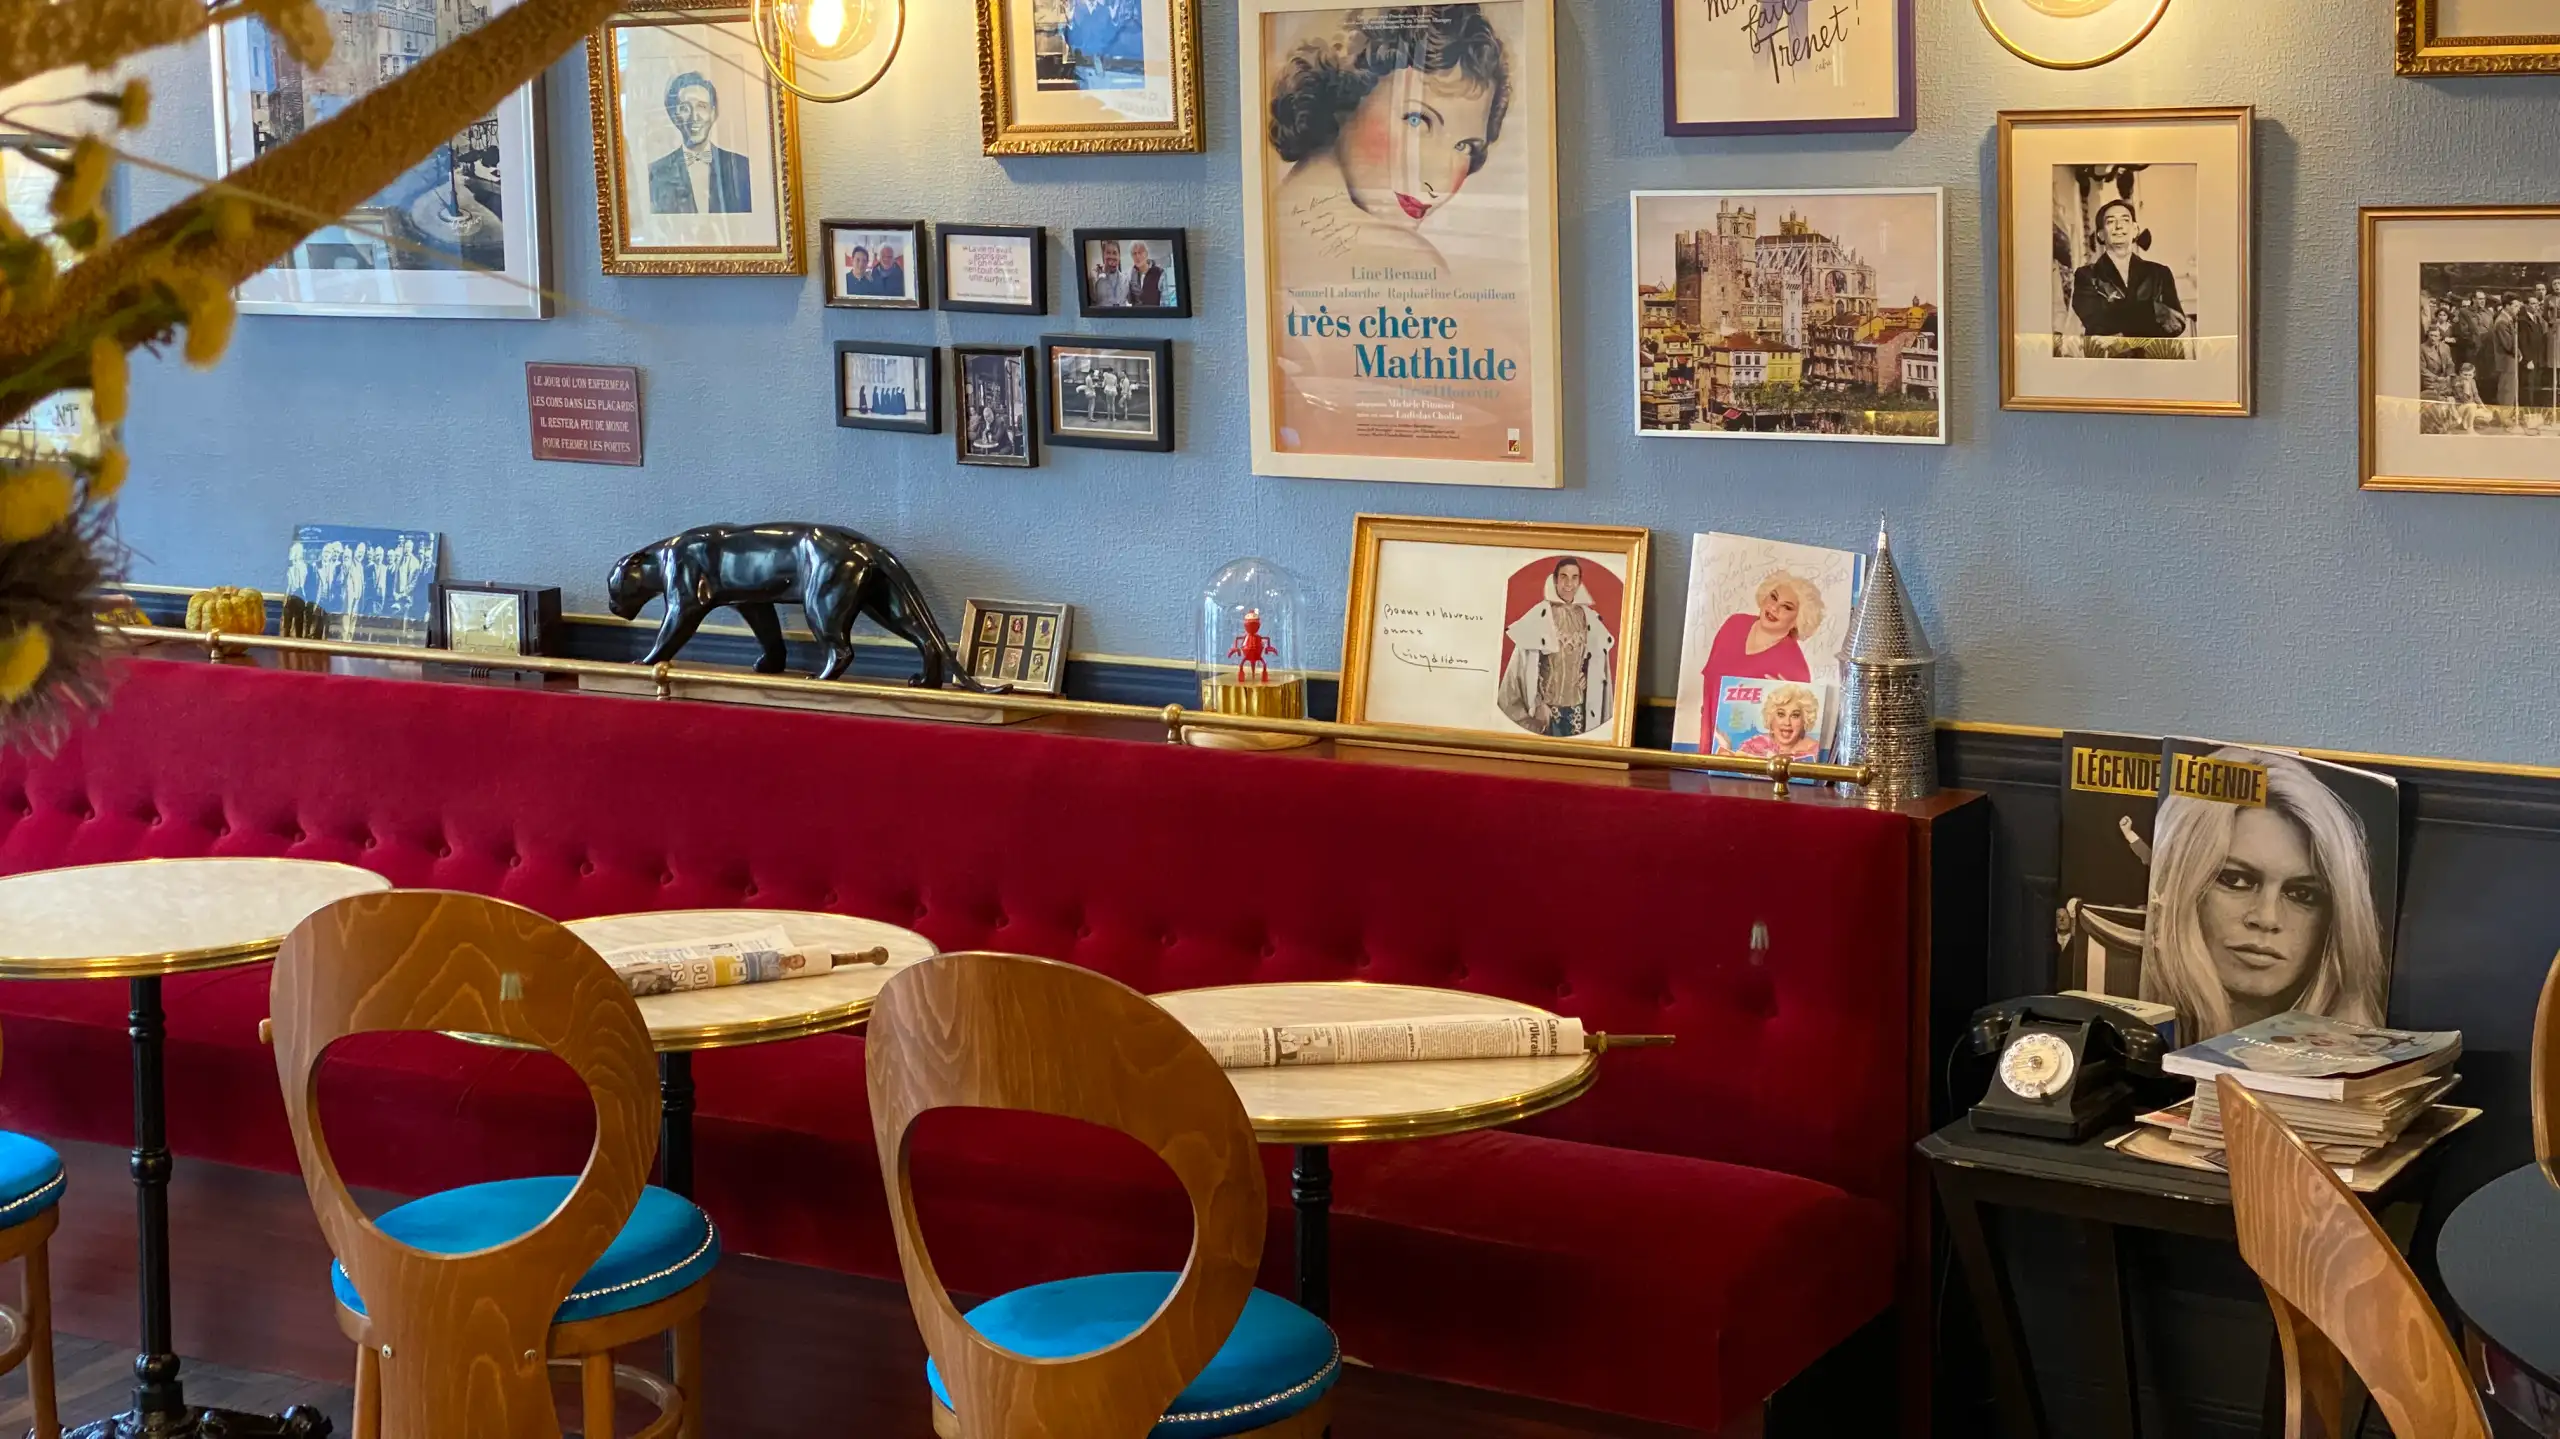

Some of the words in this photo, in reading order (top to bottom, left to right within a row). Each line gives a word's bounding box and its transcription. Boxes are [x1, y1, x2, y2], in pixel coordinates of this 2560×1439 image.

[1352, 266, 1382, 280] Line
[1384, 266, 1437, 280] Renaud
[1286, 305, 1351, 338] très
[1359, 306, 1458, 340] chère
[1353, 343, 1517, 381] Mathilde
[533, 375, 542, 386] LE
[543, 376, 561, 388] JOUR
[588, 378, 630, 391] ENFERMERA
[532, 396, 545, 407] LES
[546, 396, 563, 408] CONS
[564, 397, 583, 409] DANS
[583, 398, 597, 410] LES
[540, 416, 546, 428] IL
[547, 417, 579, 429] RESTERA
[581, 419, 594, 430] PEU
[595, 420, 604, 431] DE
[542, 437, 560, 449] POUR
[561, 438, 589, 451] FERMER
[590, 440, 602, 451] LES
[603, 441, 631, 453] PORTES
[2077, 750, 2160, 793] LÉGENDE
[2175, 755, 2263, 803] LÉGENDE
